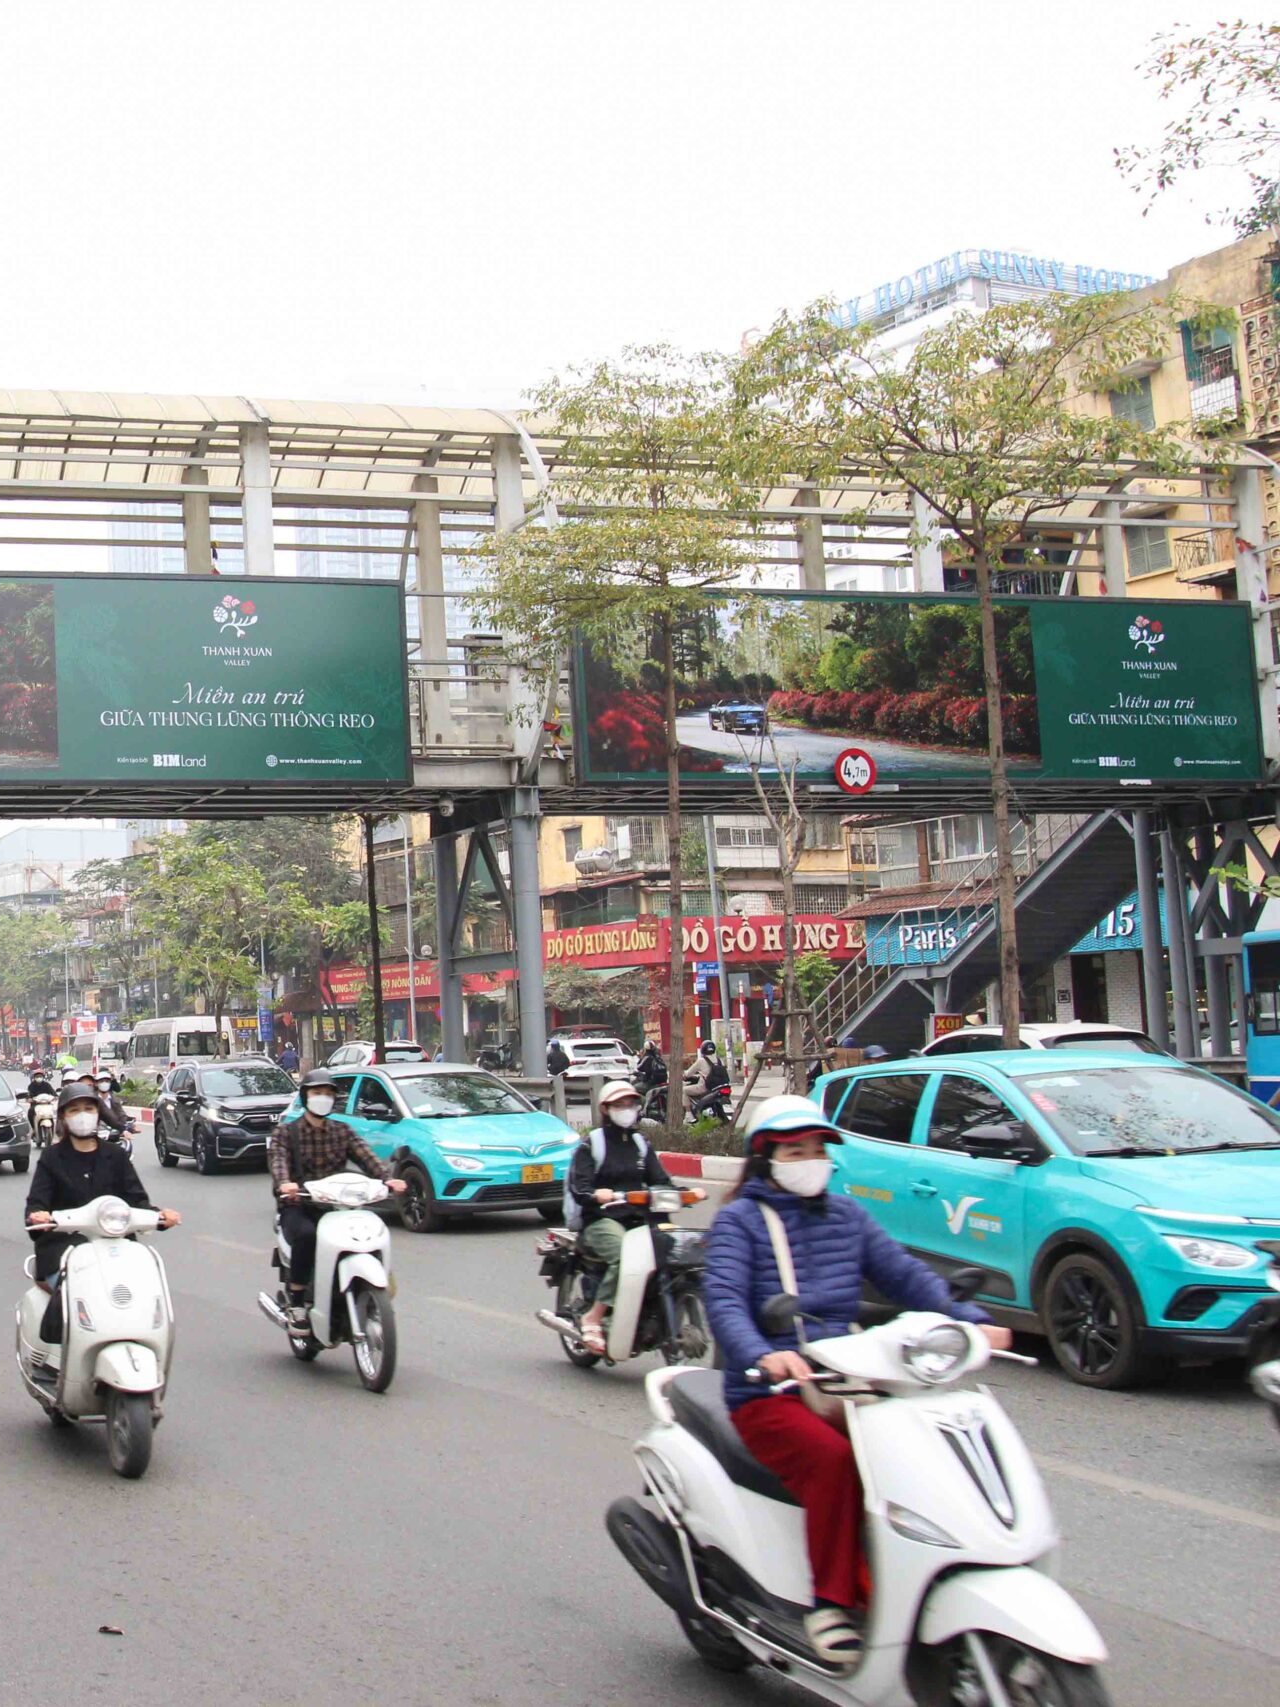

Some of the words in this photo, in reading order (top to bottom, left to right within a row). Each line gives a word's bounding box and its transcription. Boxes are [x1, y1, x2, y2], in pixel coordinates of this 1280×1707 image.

[979, 249, 1065, 290] SUNNY
[1075, 264, 1153, 295] HOTE
[202, 646, 240, 656] THANH
[243, 647, 273, 657] XUAN
[223, 659, 251, 667] VALLEY
[1121, 661, 1152, 670] THANH
[1154, 662, 1177, 671] XUAN
[172, 682, 234, 705] Miền
[242, 693, 266, 705] an
[273, 688, 305, 706] trú
[1154, 700, 1170, 709] an
[1174, 697, 1195, 710] trú
[100, 709, 145, 727] GIỮA
[149, 711, 213, 727] THUNG
[217, 710, 267, 727] LŨNG
[271, 710, 334, 728] THÔNG
[339, 714, 375, 729] REO
[1099, 714, 1138, 725] THUNG
[1214, 715, 1237, 726] REO
[622, 929, 657, 952] LONG
[899, 924, 957, 951] Paris
[414, 974, 432, 986] DÂN
